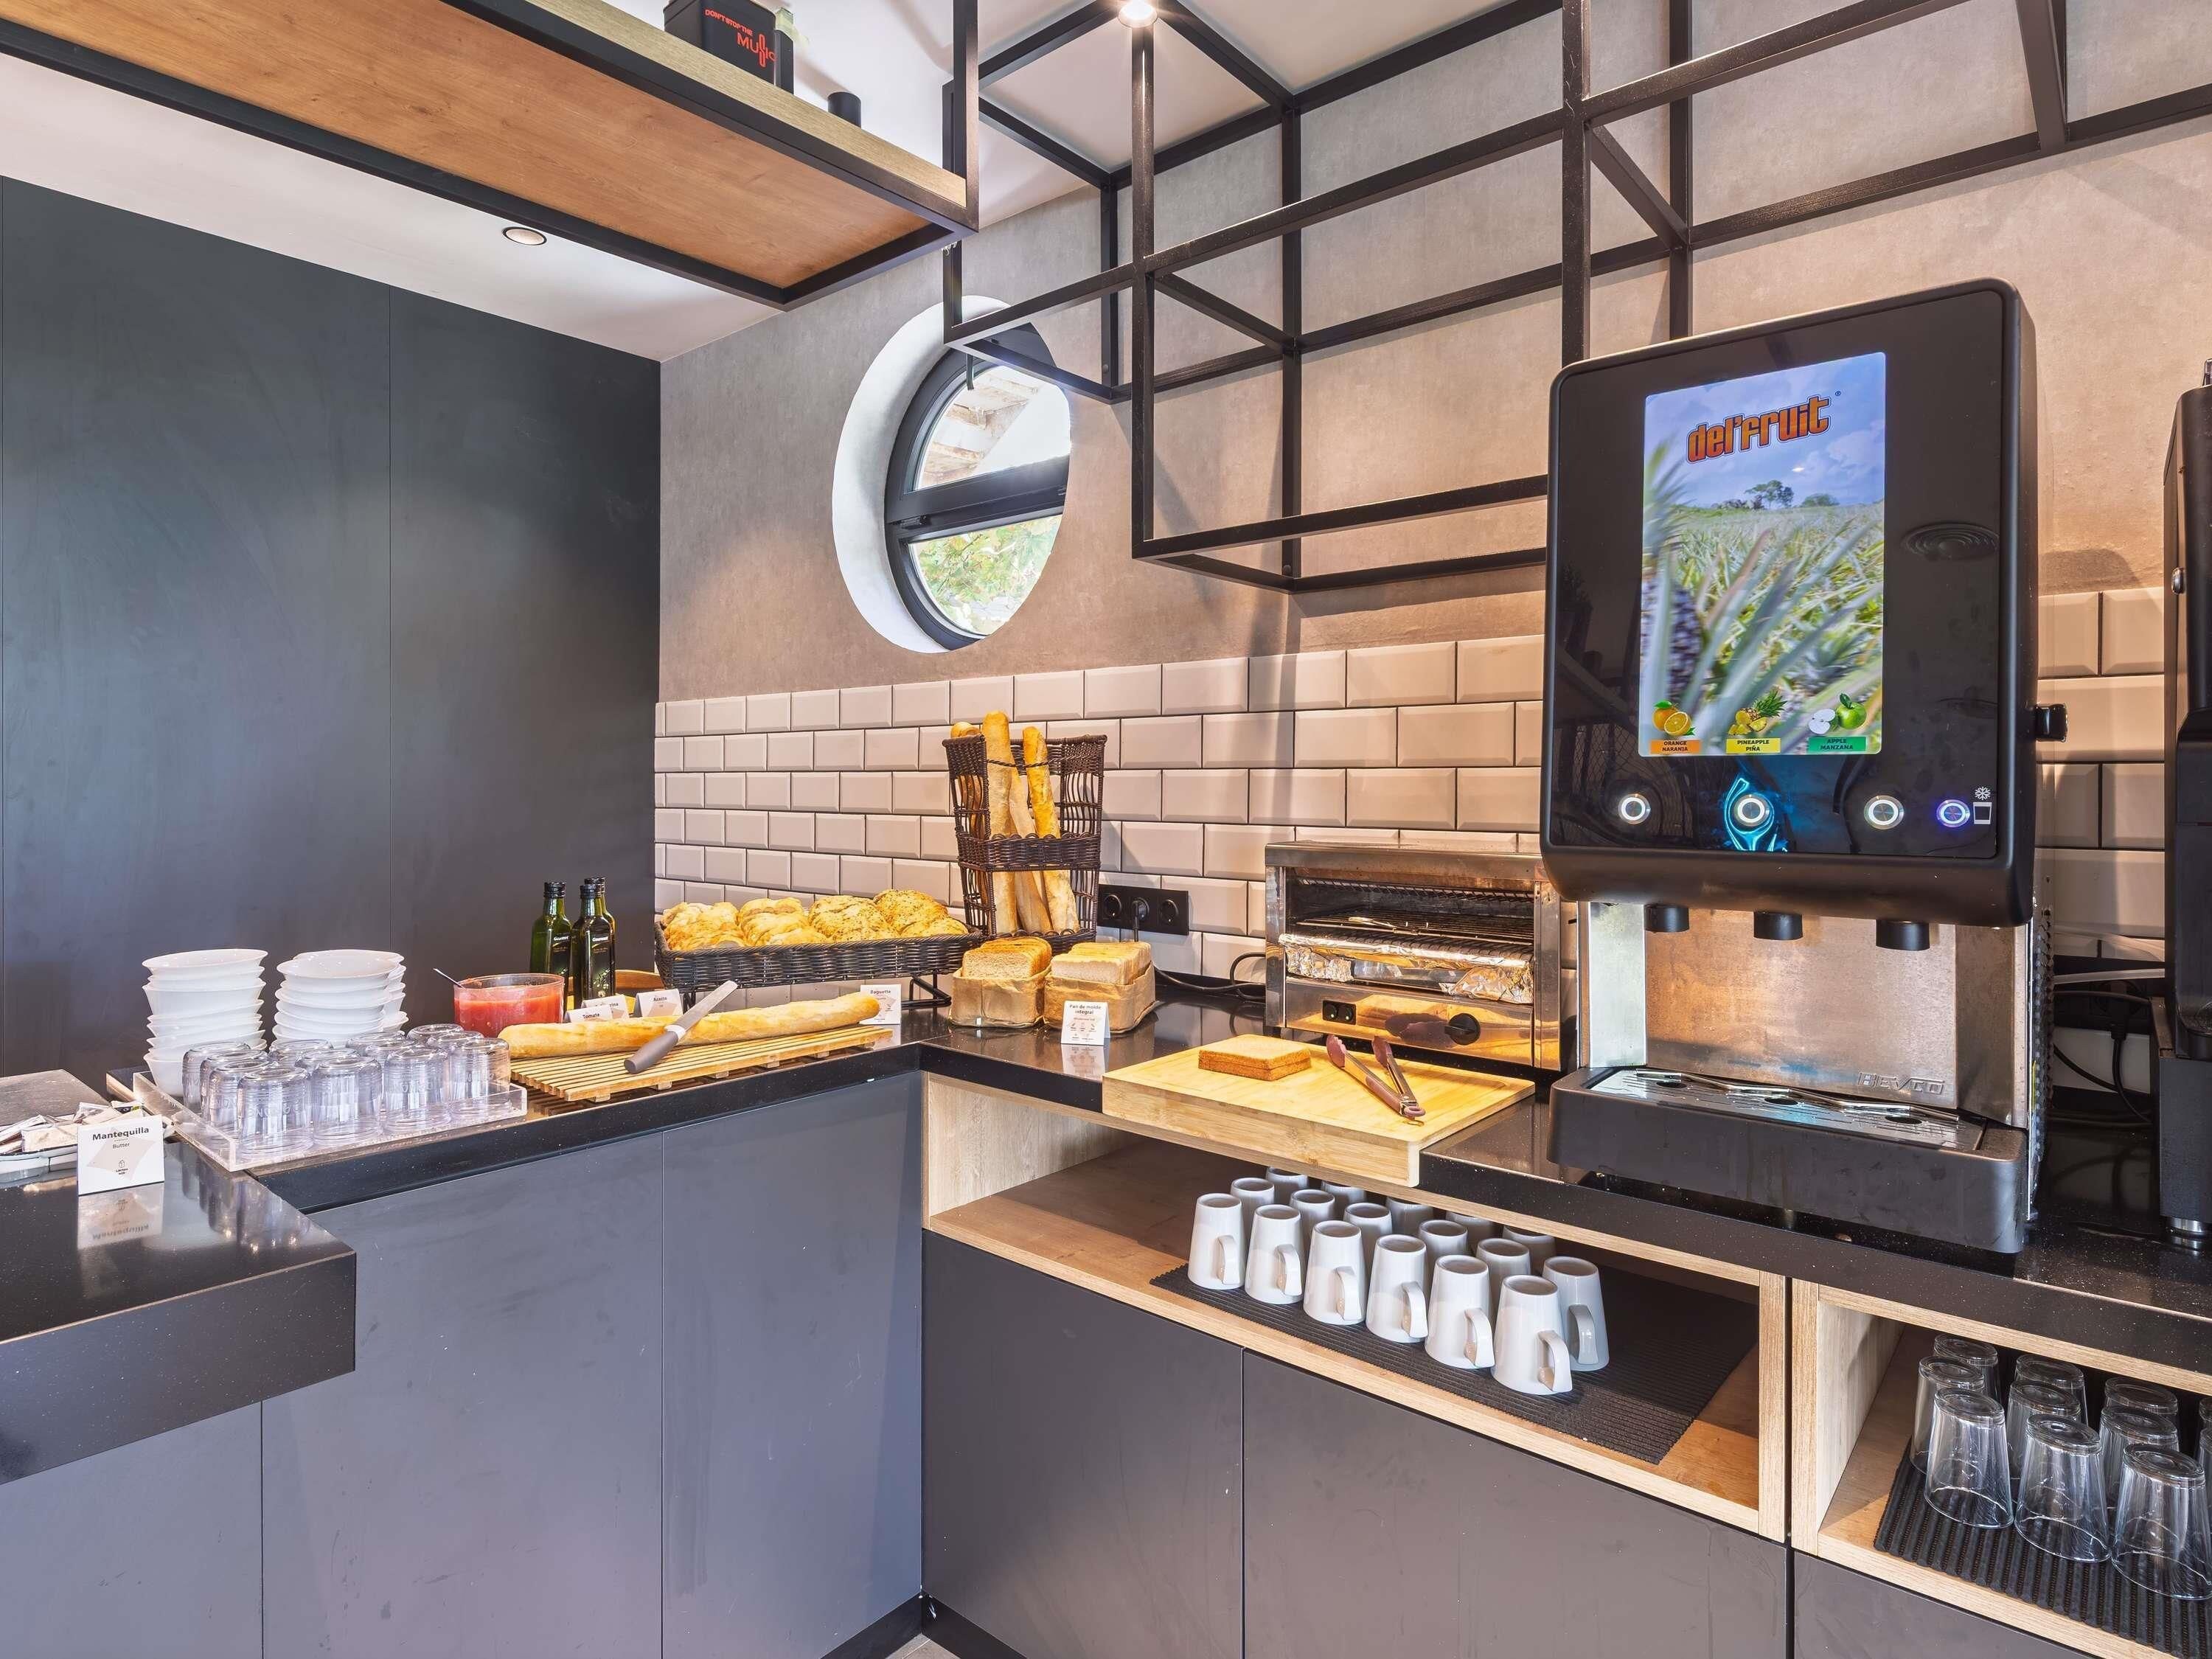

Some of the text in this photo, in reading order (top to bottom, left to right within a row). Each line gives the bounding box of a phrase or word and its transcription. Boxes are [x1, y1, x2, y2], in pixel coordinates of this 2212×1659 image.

[726, 17, 741, 29] STOP
[741, 24, 753, 36] THE
[1687, 394, 1831, 463] del'fruit
[92, 1127, 150, 1141] Mantequilla
